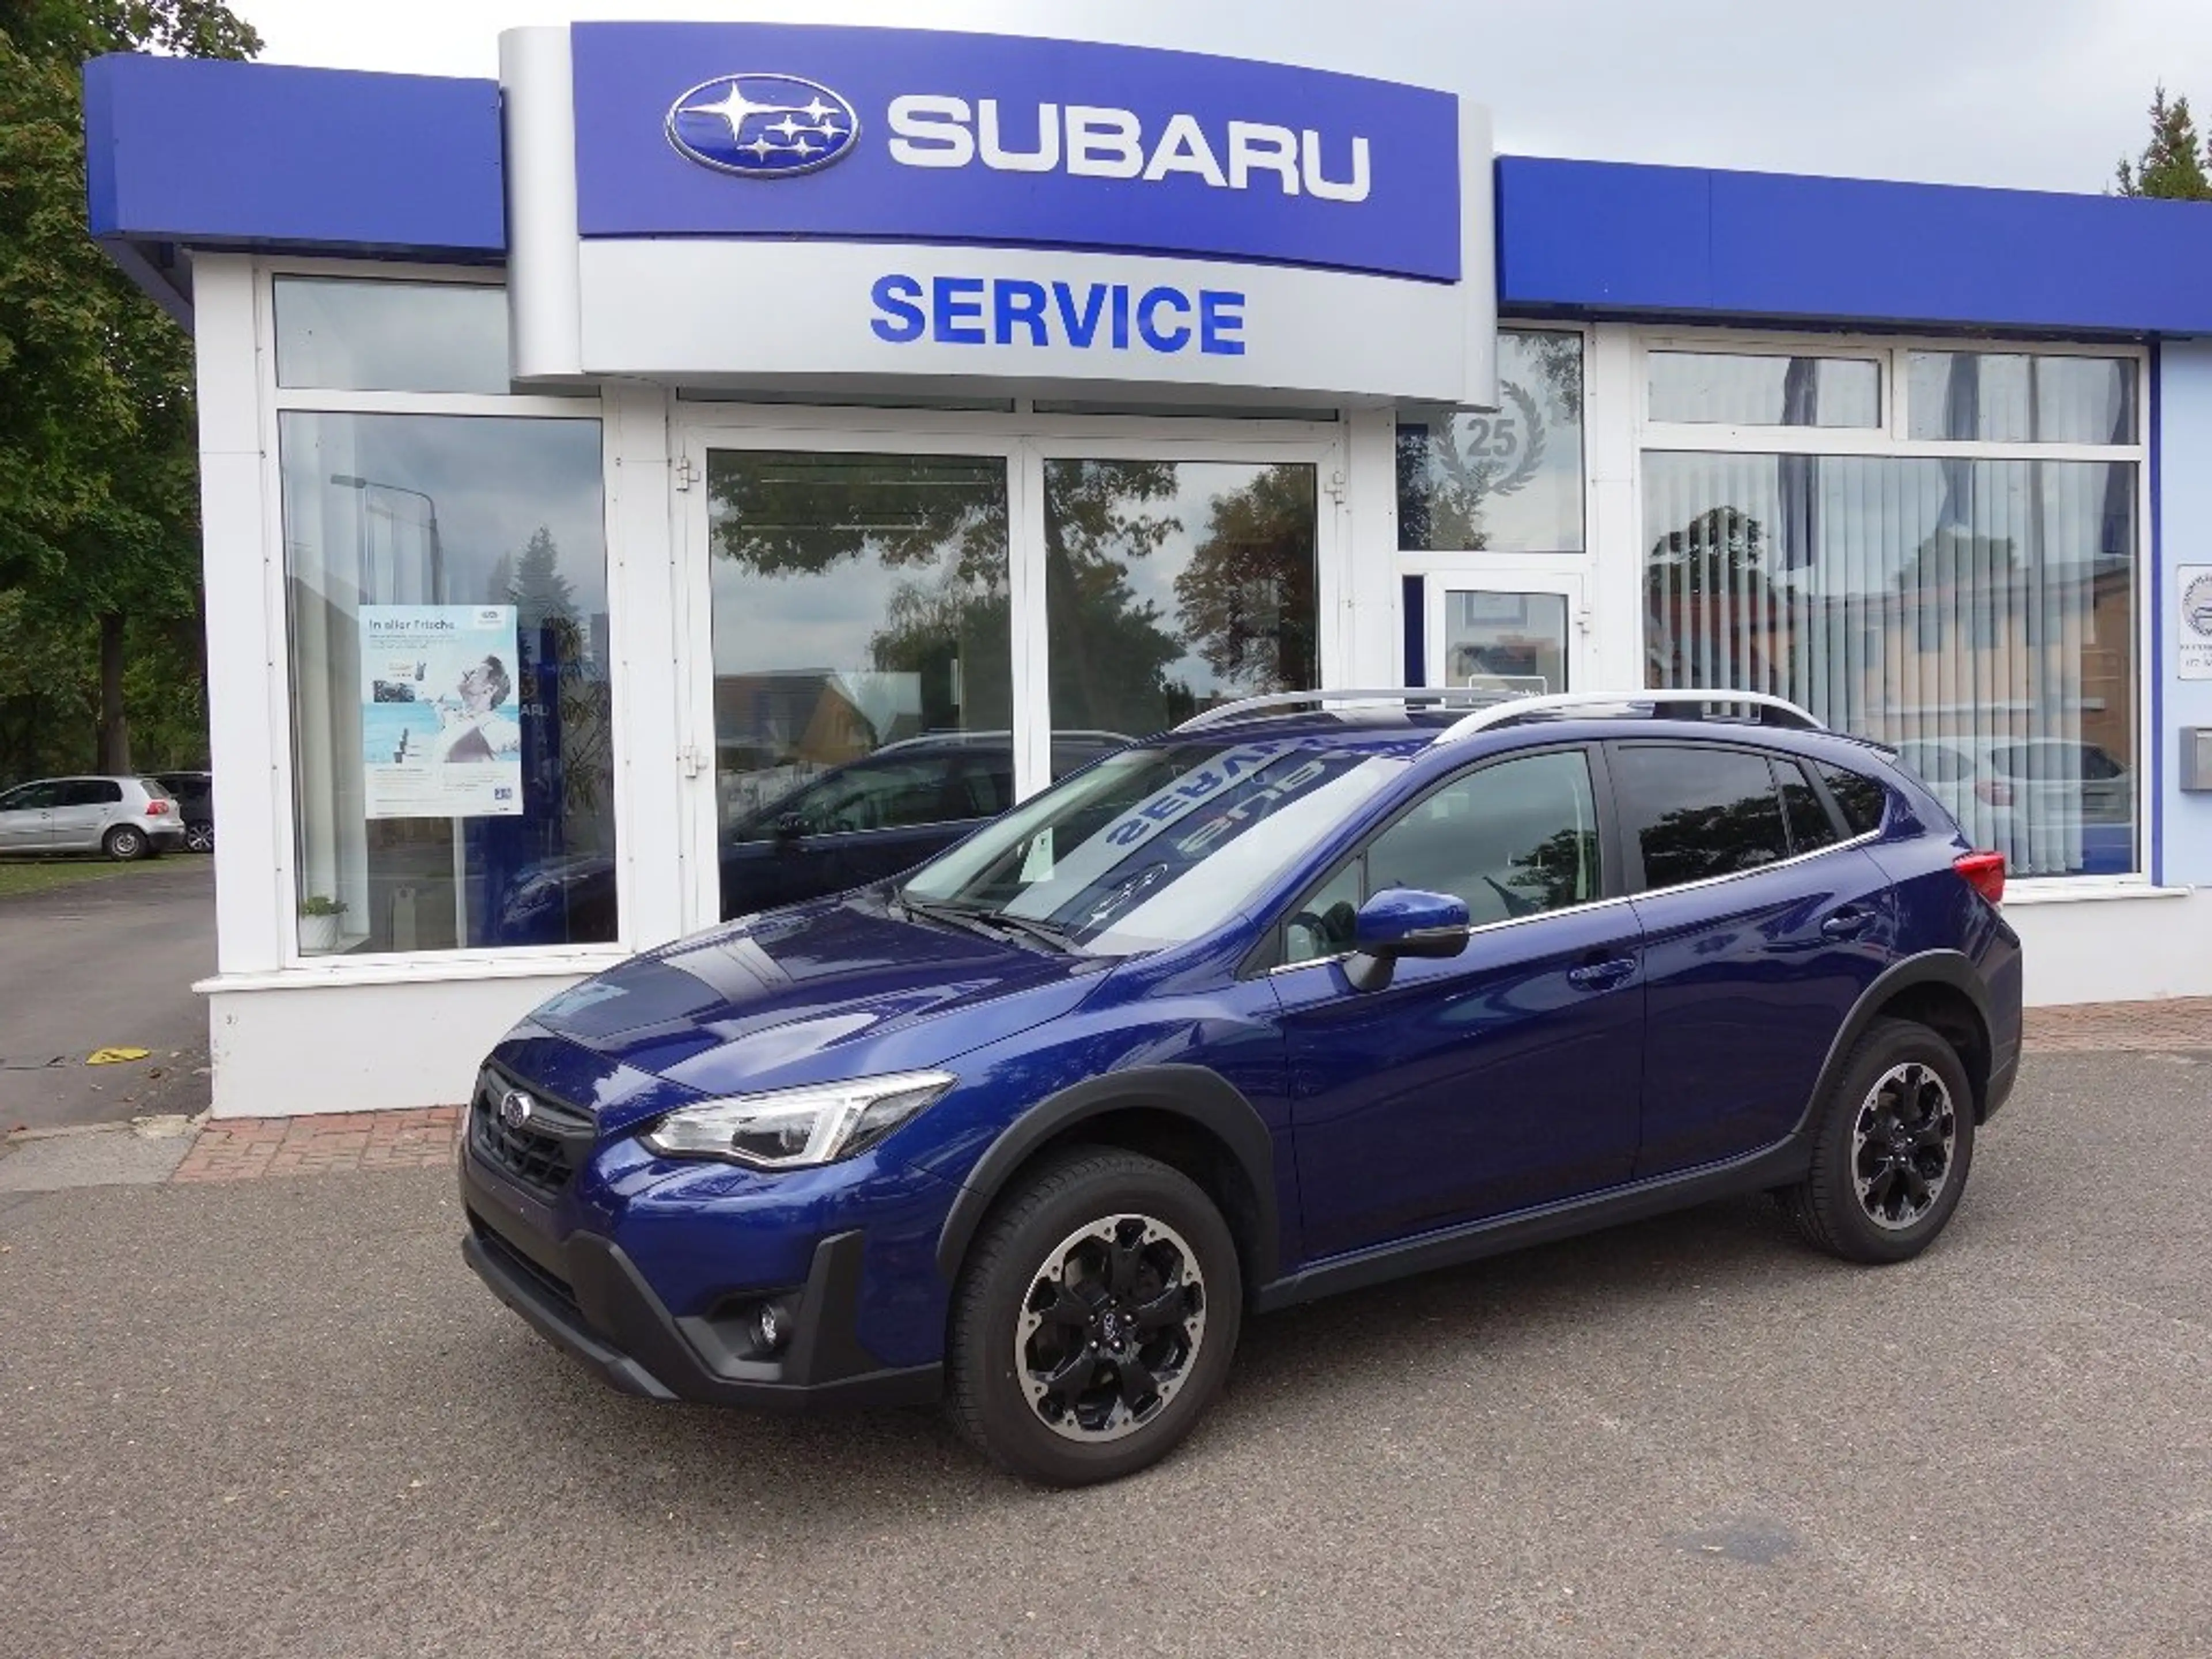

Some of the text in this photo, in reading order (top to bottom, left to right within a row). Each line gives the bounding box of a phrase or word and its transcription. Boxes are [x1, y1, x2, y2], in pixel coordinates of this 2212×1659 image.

[888, 94, 1371, 202] SUBARU
[870, 274, 1246, 355] SERVICE
[1467, 418, 1517, 457] 25
[369, 619, 381, 629] In
